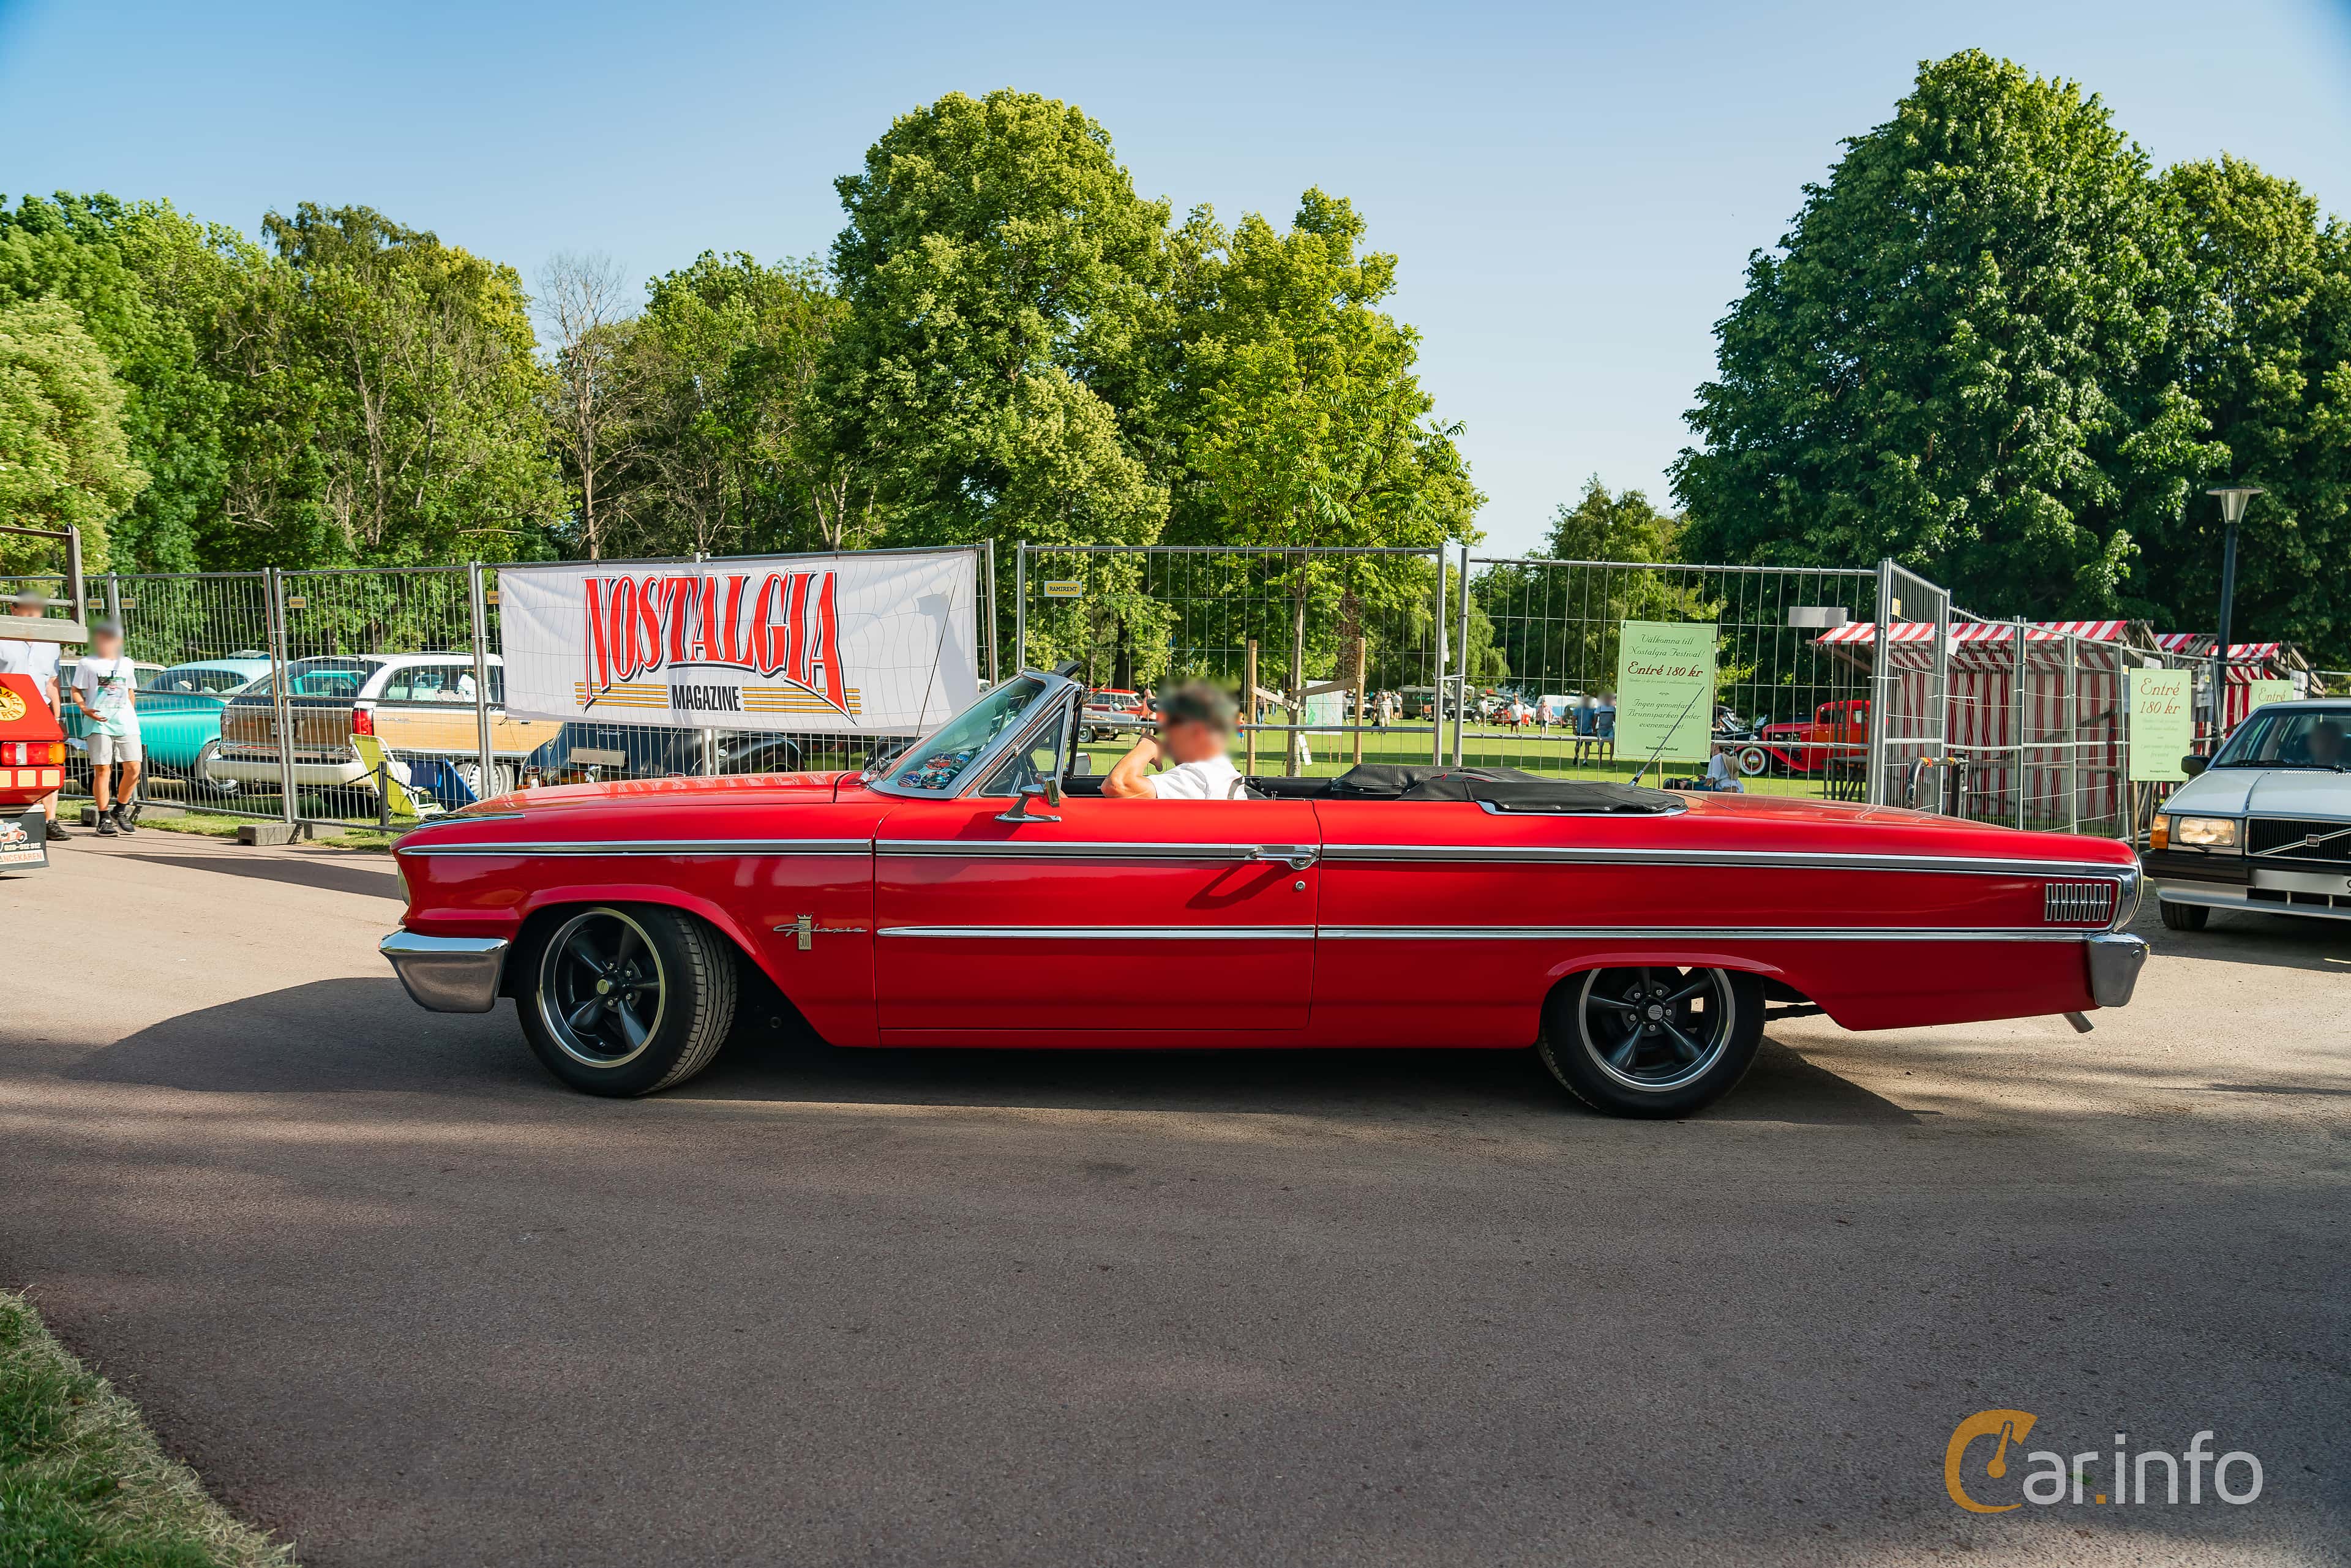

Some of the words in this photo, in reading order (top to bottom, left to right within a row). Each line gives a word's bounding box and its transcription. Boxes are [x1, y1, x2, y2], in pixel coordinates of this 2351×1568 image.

[581, 568, 858, 726] NOSTALGIA
[1641, 634, 1680, 645] Välkomna
[1682, 637, 1695, 645] till
[1629, 646, 1667, 659] Nostalgia
[1670, 648, 1705, 658] Festival!
[1627, 661, 1665, 675] Entré
[1666, 666, 1687, 677] 180
[1687, 664, 1703, 677] kr
[2140, 678, 2180, 696] Entré
[2258, 686, 2286, 702] Entré
[672, 685, 741, 712] MAGAZINE
[1632, 699, 1655, 710] Ingen
[2140, 701, 2162, 714] 180
[2164, 697, 2180, 714] kr
[1627, 709, 1679, 720] Brunnsparken
[1680, 711, 1702, 720] nder
[773, 923, 868, 937] Galaxie
[800, 934, 809, 947] 500
